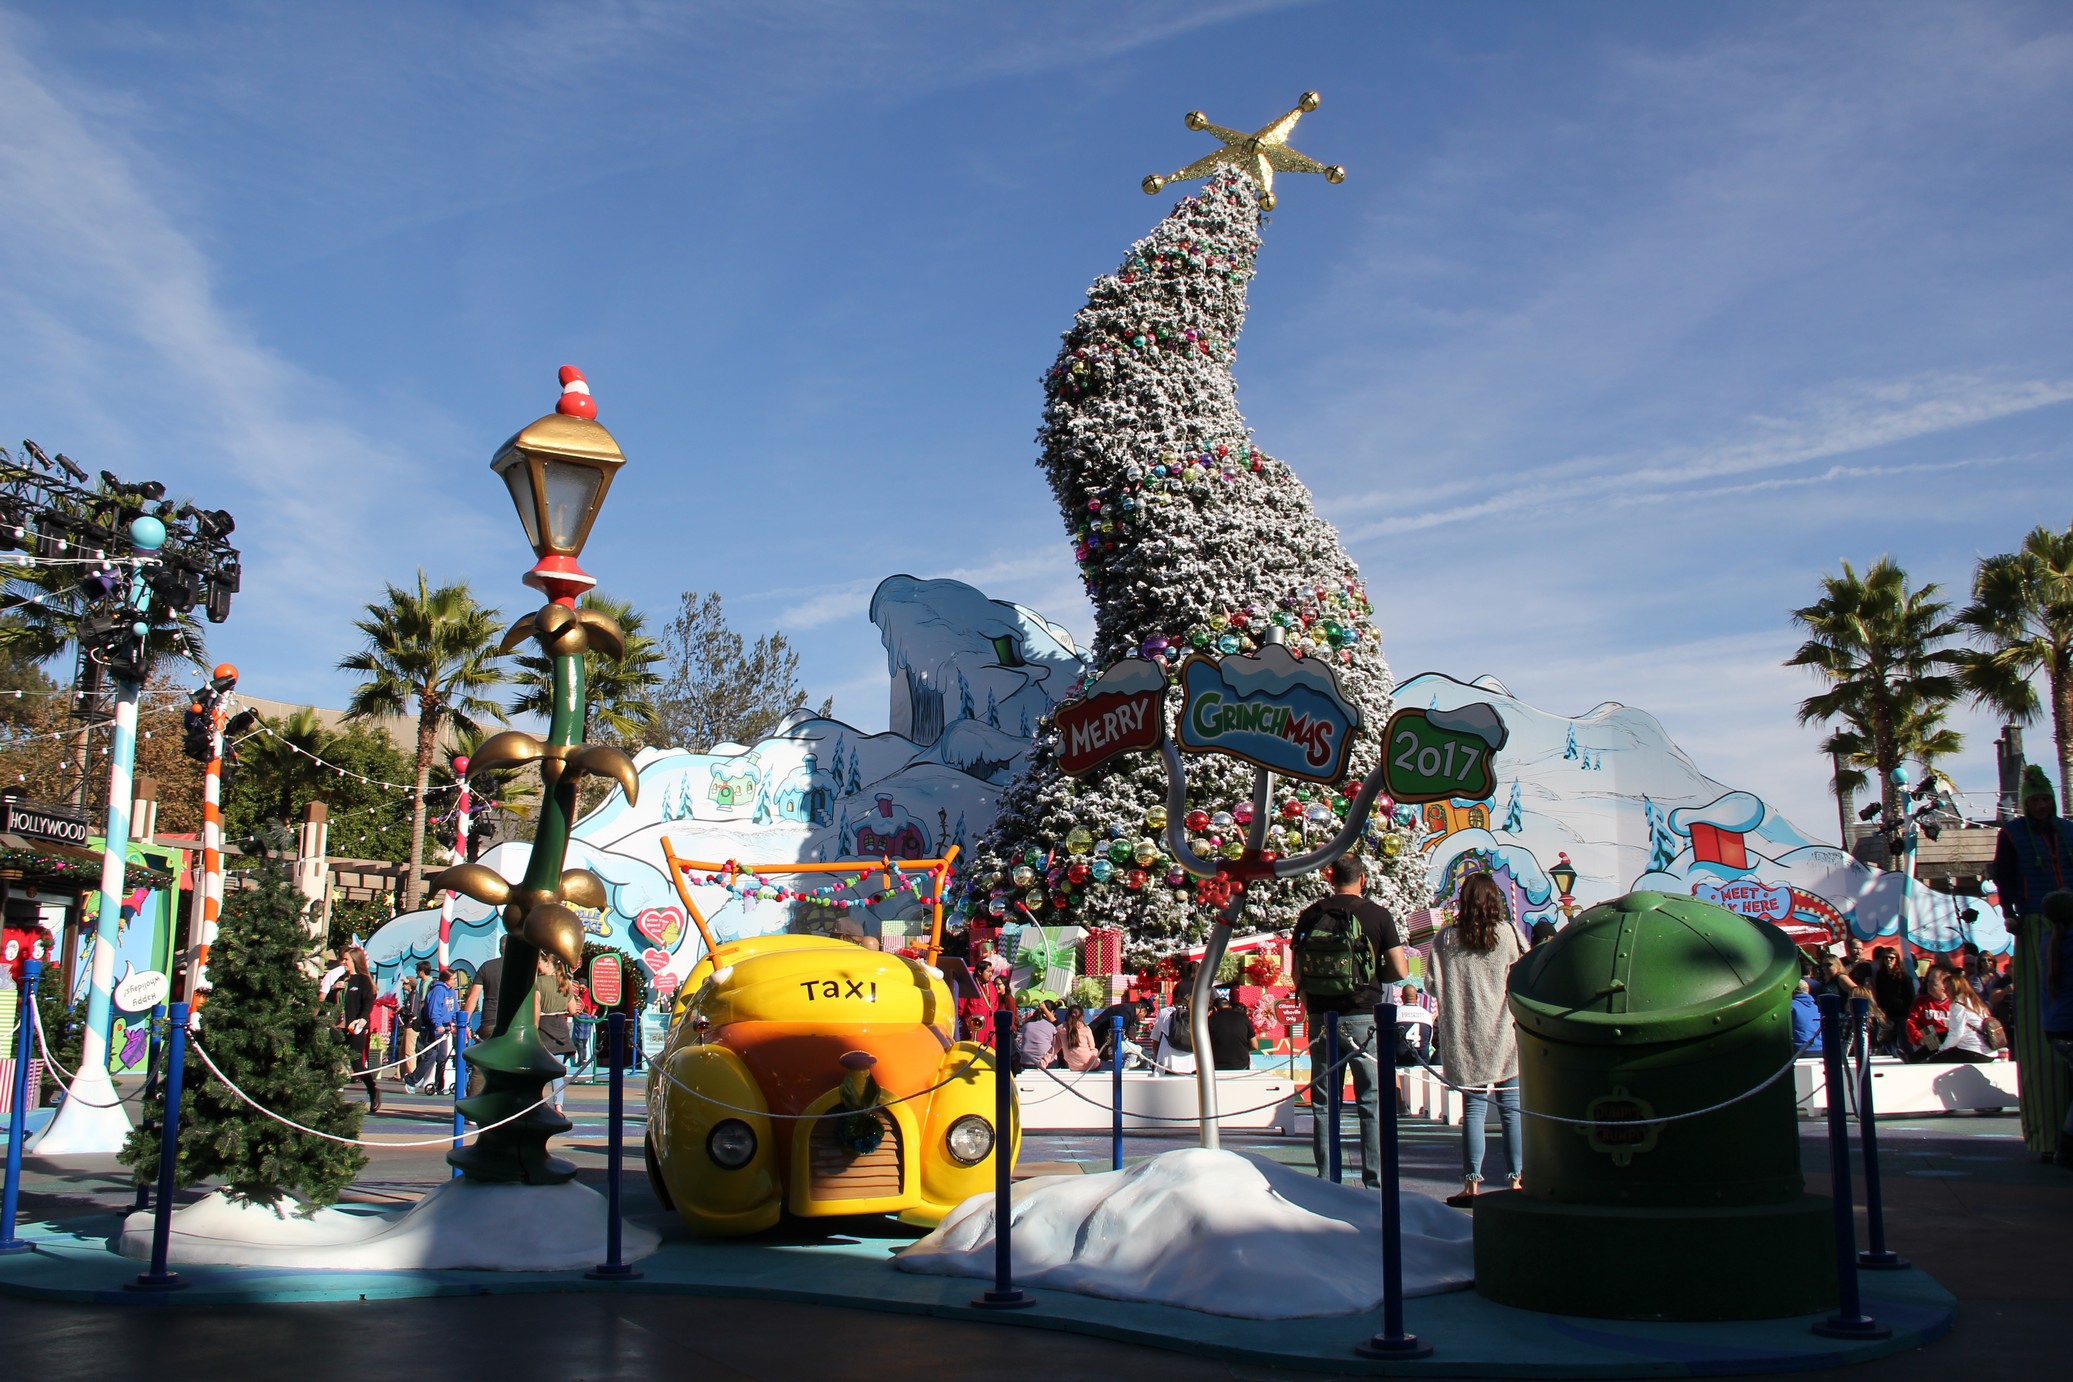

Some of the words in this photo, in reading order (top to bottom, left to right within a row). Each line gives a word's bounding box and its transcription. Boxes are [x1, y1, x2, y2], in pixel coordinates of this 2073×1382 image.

[1071, 697, 1149, 758] MERRY
[1192, 691, 1334, 768] GRINCHMAS
[1394, 730, 1480, 781] 2017
[10, 811, 86, 841] HOLLYWOOD
[1720, 886, 1760, 902] MEET
[1742, 898, 1780, 913] HERE
[132, 992, 157, 1006] Happy
[1405, 1022, 1422, 1048] 4
